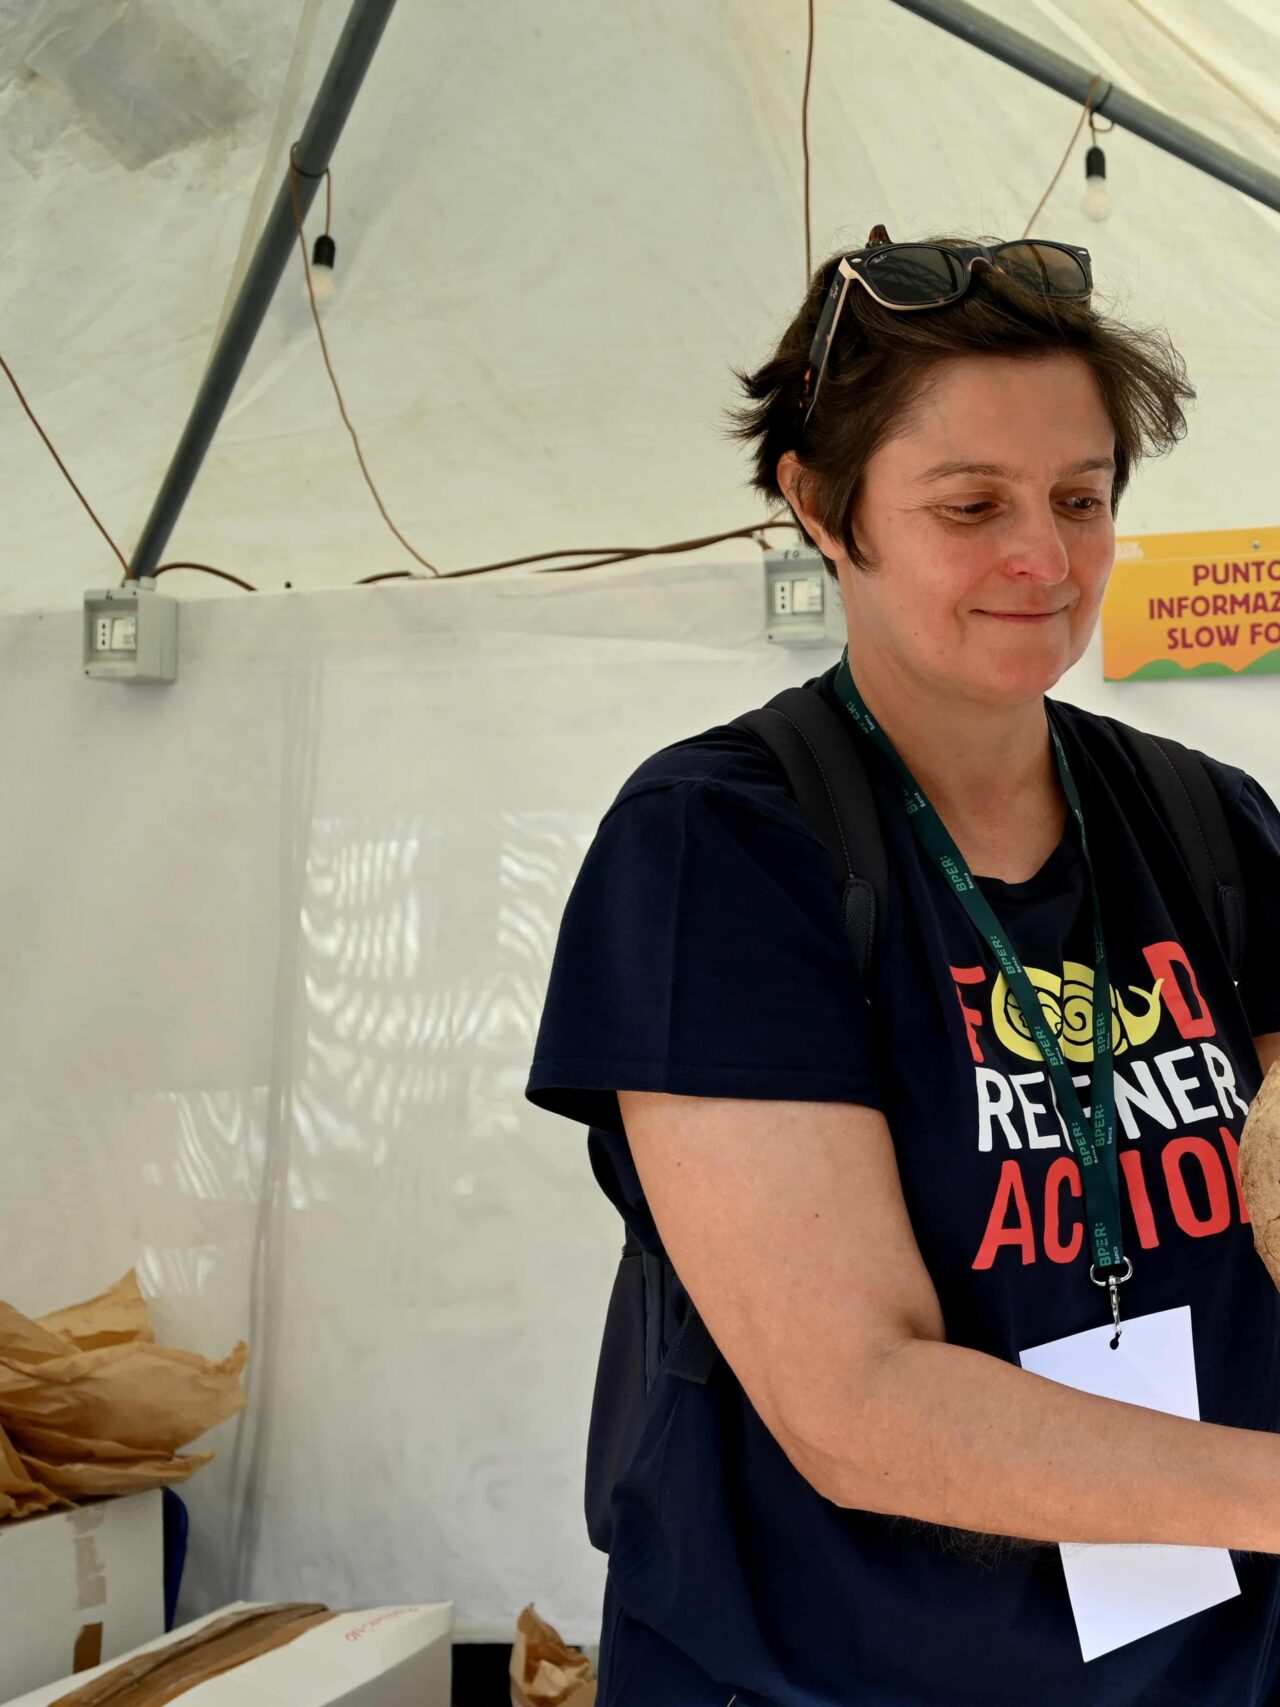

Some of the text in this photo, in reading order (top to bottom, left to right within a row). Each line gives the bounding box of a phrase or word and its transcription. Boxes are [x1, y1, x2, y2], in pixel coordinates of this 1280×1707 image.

[1167, 625, 1239, 649] SLOW
[975, 1042, 1249, 1152] RENER
[971, 1127, 1251, 1270] ACIO
